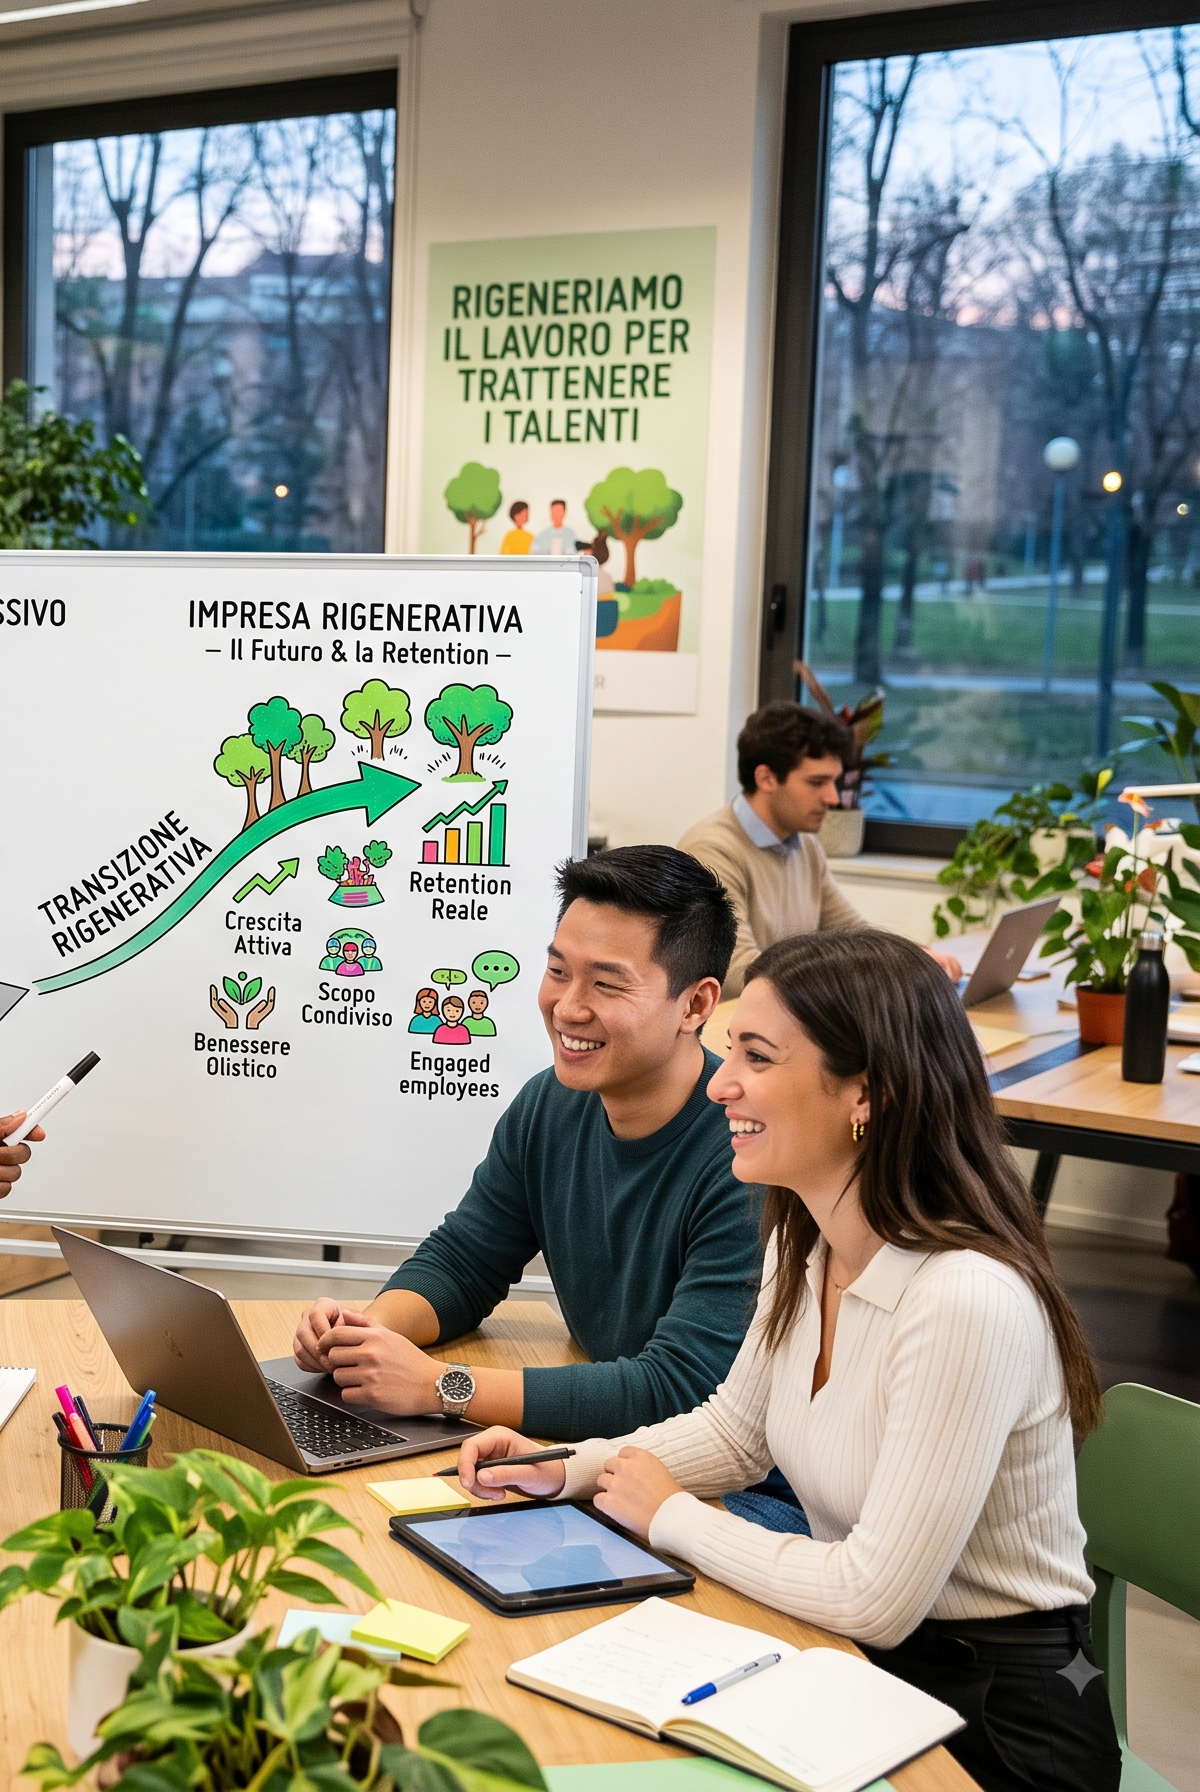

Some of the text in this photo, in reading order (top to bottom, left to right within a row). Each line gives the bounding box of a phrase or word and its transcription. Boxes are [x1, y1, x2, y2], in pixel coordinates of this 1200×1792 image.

[453, 274, 684, 319] RIGENERIAMO
[444, 318, 690, 361] IL LAVORO PER
[458, 363, 671, 402] TRATTENERE
[485, 407, 639, 443] I TALENTI
[189, 599, 523, 634] IMPRESA RIGENERATIVA
[231, 638, 243, 661] Il
[251, 638, 323, 662] Futuro
[331, 639, 348, 663] &
[355, 639, 373, 663] la
[382, 641, 489, 665] Retention
[37, 810, 190, 925] TRANSIZIONE
[409, 871, 511, 896] Retention
[51, 836, 213, 958] RIGENERATIVA
[431, 898, 488, 921] Reale
[225, 910, 302, 933] Crescita
[234, 934, 292, 956] Attiva
[318, 982, 376, 1005] Scopo
[301, 1004, 393, 1027] Condiviso
[194, 1032, 291, 1056] Benessere
[206, 1056, 277, 1079] Olistico
[410, 1051, 490, 1077] Engaged
[399, 1077, 500, 1101] employees
